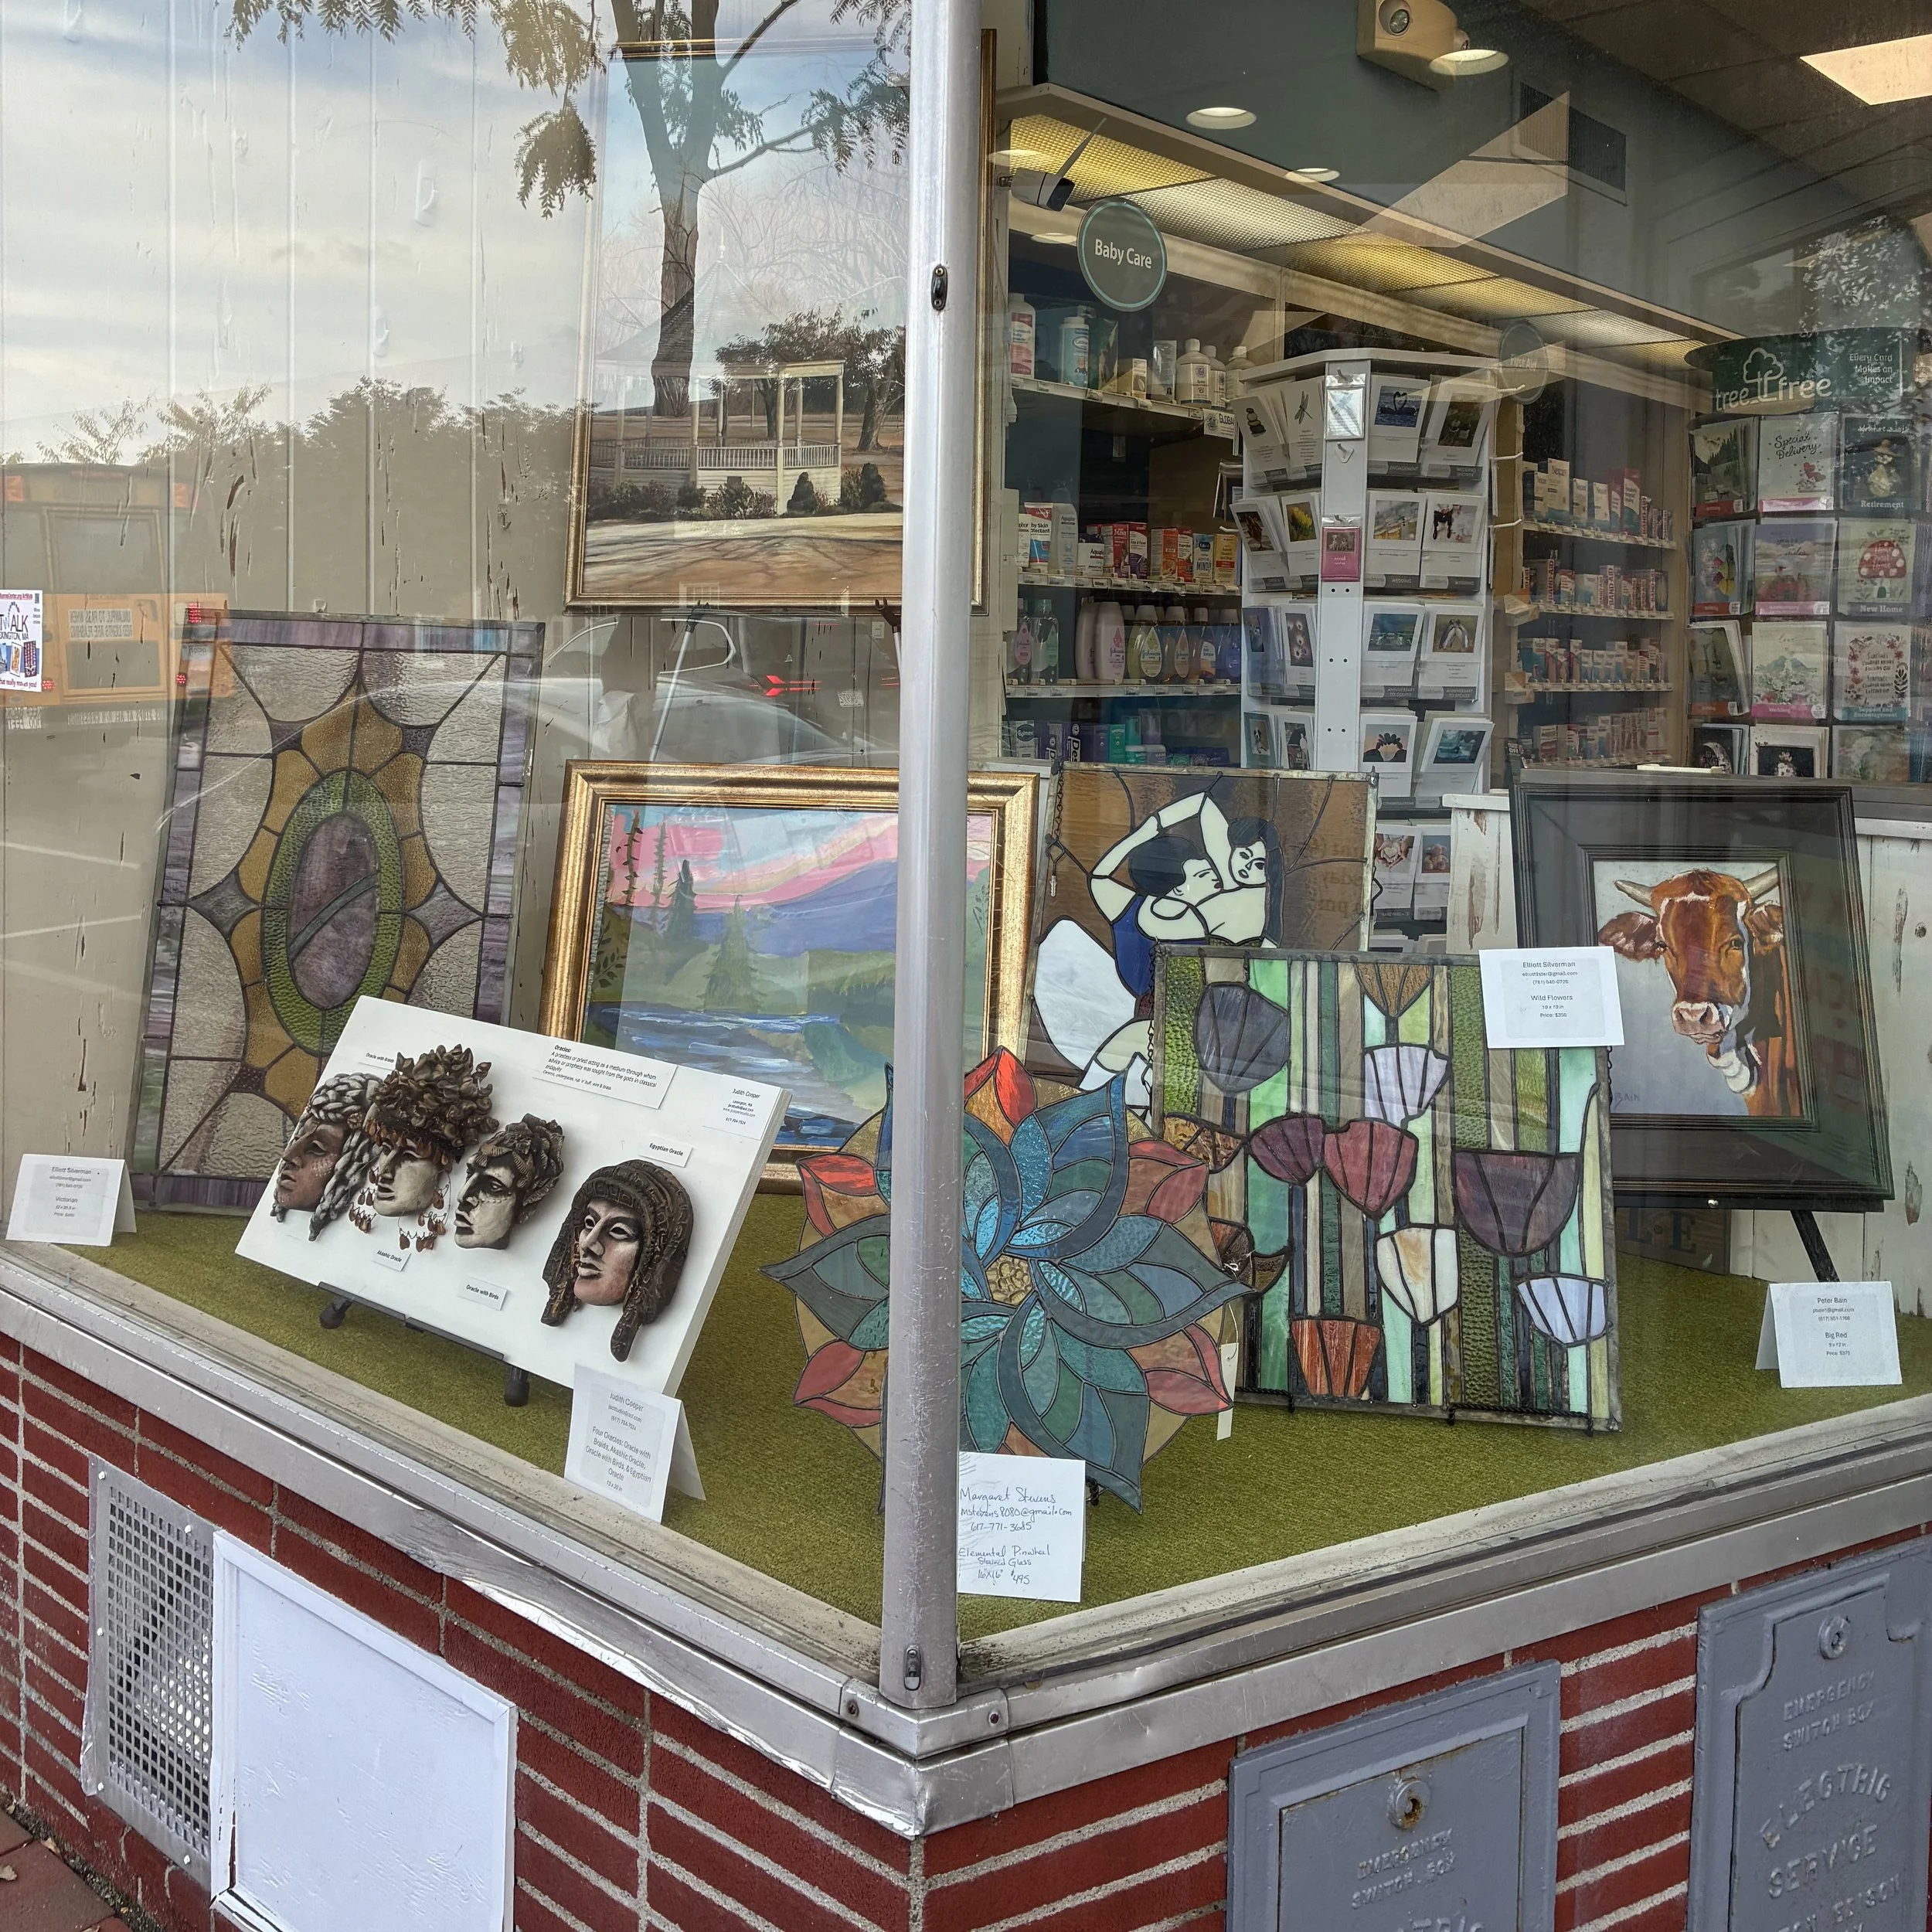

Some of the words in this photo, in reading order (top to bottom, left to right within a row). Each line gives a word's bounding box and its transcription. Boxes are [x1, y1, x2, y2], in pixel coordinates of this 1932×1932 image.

[1094, 239, 1124, 265] Baby
[1126, 247, 1152, 269] Care
[1873, 353, 1893, 362] Card
[1865, 376, 1893, 386] Impact
[1716, 387, 1749, 412] tree
[1778, 376, 1832, 401] free
[1219, 413, 1235, 425] GLOBA
[1774, 430, 1811, 451] Special
[1776, 442, 1821, 460] Delivery
[1861, 500, 1904, 509] Retirement
[745, 1090, 761, 1099] Cooper
[649, 1142, 668, 1153] Egyptian
[668, 1147, 684, 1157] Oracle
[466, 1284, 480, 1293] Oracle
[610, 1392, 625, 1404] Judith
[625, 1399, 644, 1412] Cooper
[593, 1426, 604, 1437] Four
[604, 1431, 624, 1447] Oracles:
[624, 1440, 639, 1454] Oracle
[639, 1448, 651, 1460] with
[593, 1437, 610, 1452] Braids,
[610, 1446, 628, 1461] Akashic
[628, 1454, 646, 1470] Oracle,
[585, 1445, 601, 1459] Oracle
[601, 1453, 612, 1464] with
[612, 1458, 626, 1471] Birds,
[630, 1468, 652, 1483] Egyptian
[607, 1468, 624, 1482] Oracle
[960, 1487, 1010, 1512] Margaret
[1015, 1487, 1056, 1504] Stevens
[958, 1545, 1006, 1558] Elemental
[1012, 1544, 1050, 1556] Pinwheel
[977, 1556, 1006, 1566] Stained
[1008, 1557, 1032, 1568] Glass
[1010, 1569, 1030, 1585] $495
[1782, 1670, 1876, 1723] EMERGENCY
[1782, 1713, 1841, 1752] SWITCH
[1768, 1825, 1878, 1899] SERVICE
